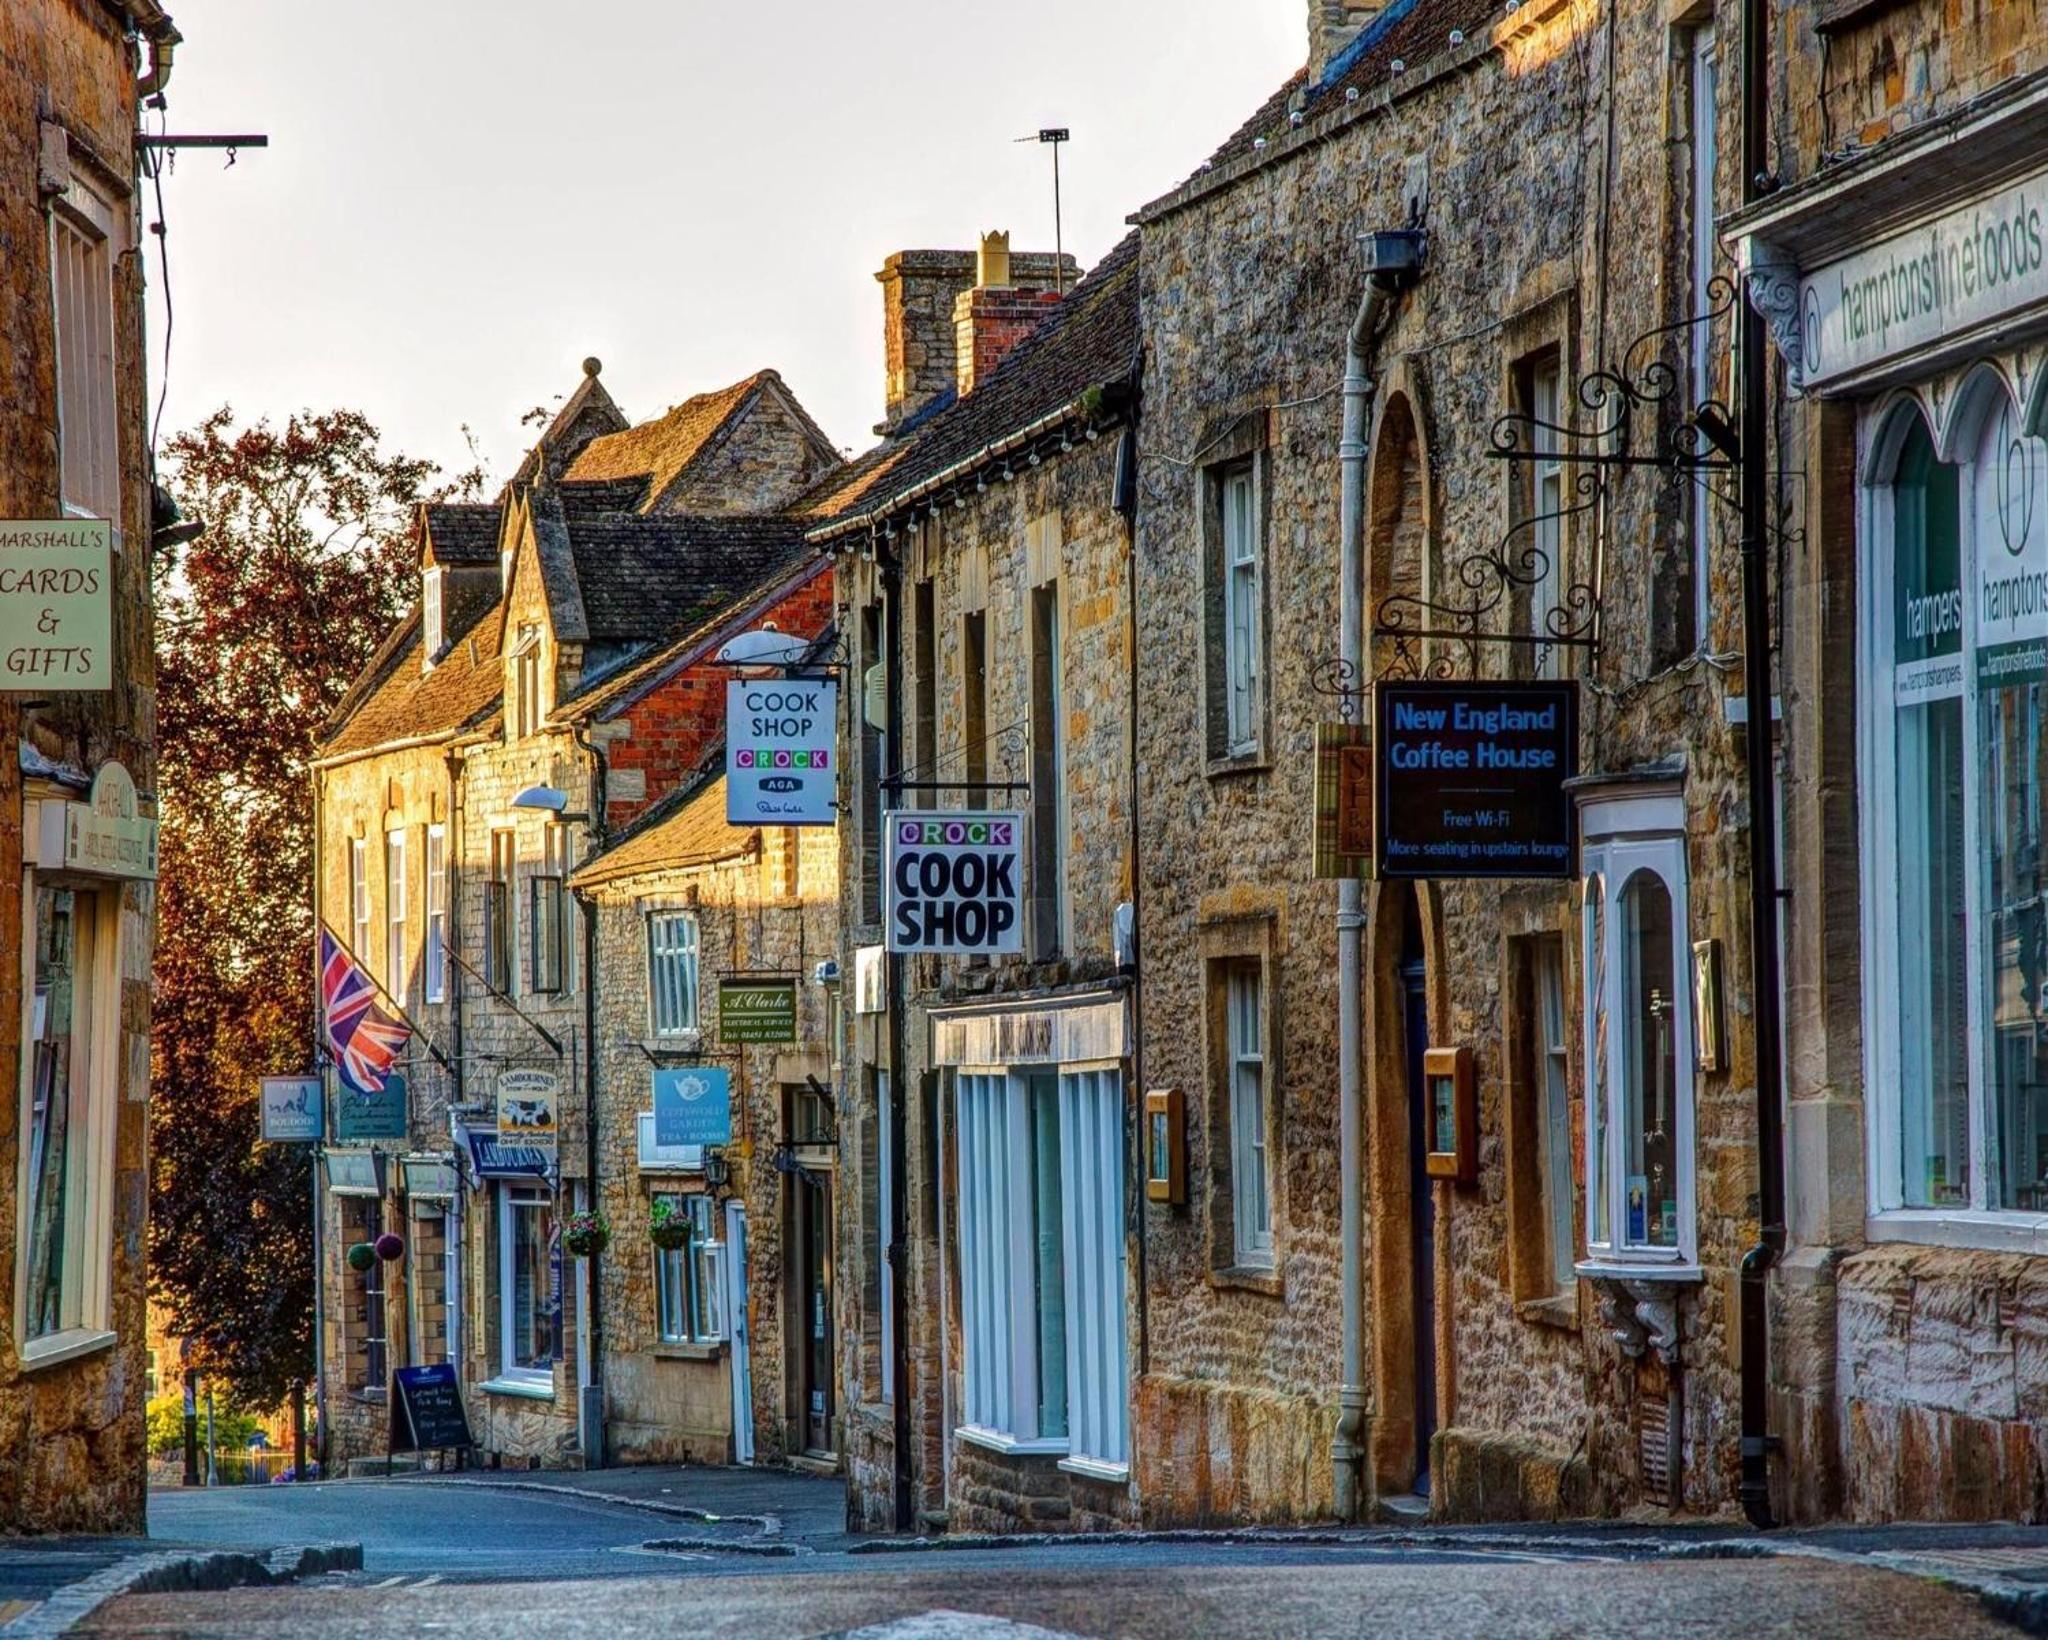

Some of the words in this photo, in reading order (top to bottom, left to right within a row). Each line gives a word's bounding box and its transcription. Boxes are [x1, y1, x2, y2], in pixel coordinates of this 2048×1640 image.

[1840, 192, 2043, 350] hamptonsfinefoods
[0, 568, 99, 594] CARDS
[37, 608, 60, 635] &
[1907, 588, 1961, 648] hampers
[7, 646, 92, 676] GIFTS
[746, 692, 819, 712] COOK
[752, 718, 813, 737] SHOP
[1395, 703, 1446, 731] New
[1454, 703, 1556, 734] England
[737, 750, 826, 768] CROCK
[1391, 743, 1470, 768] Coffee
[1477, 743, 1556, 768] House
[767, 780, 795, 790] AGA
[1443, 811, 1472, 827] Free
[1476, 811, 1510, 827] Wi-Fi
[900, 823, 1011, 844] CROCK
[1387, 840, 1420, 855] More
[1424, 840, 1469, 858] seating
[1471, 840, 1482, 855] in
[1484, 840, 1529, 858] upstairs
[896, 852, 1016, 898] COOK
[896, 901, 1014, 946] SHOP
